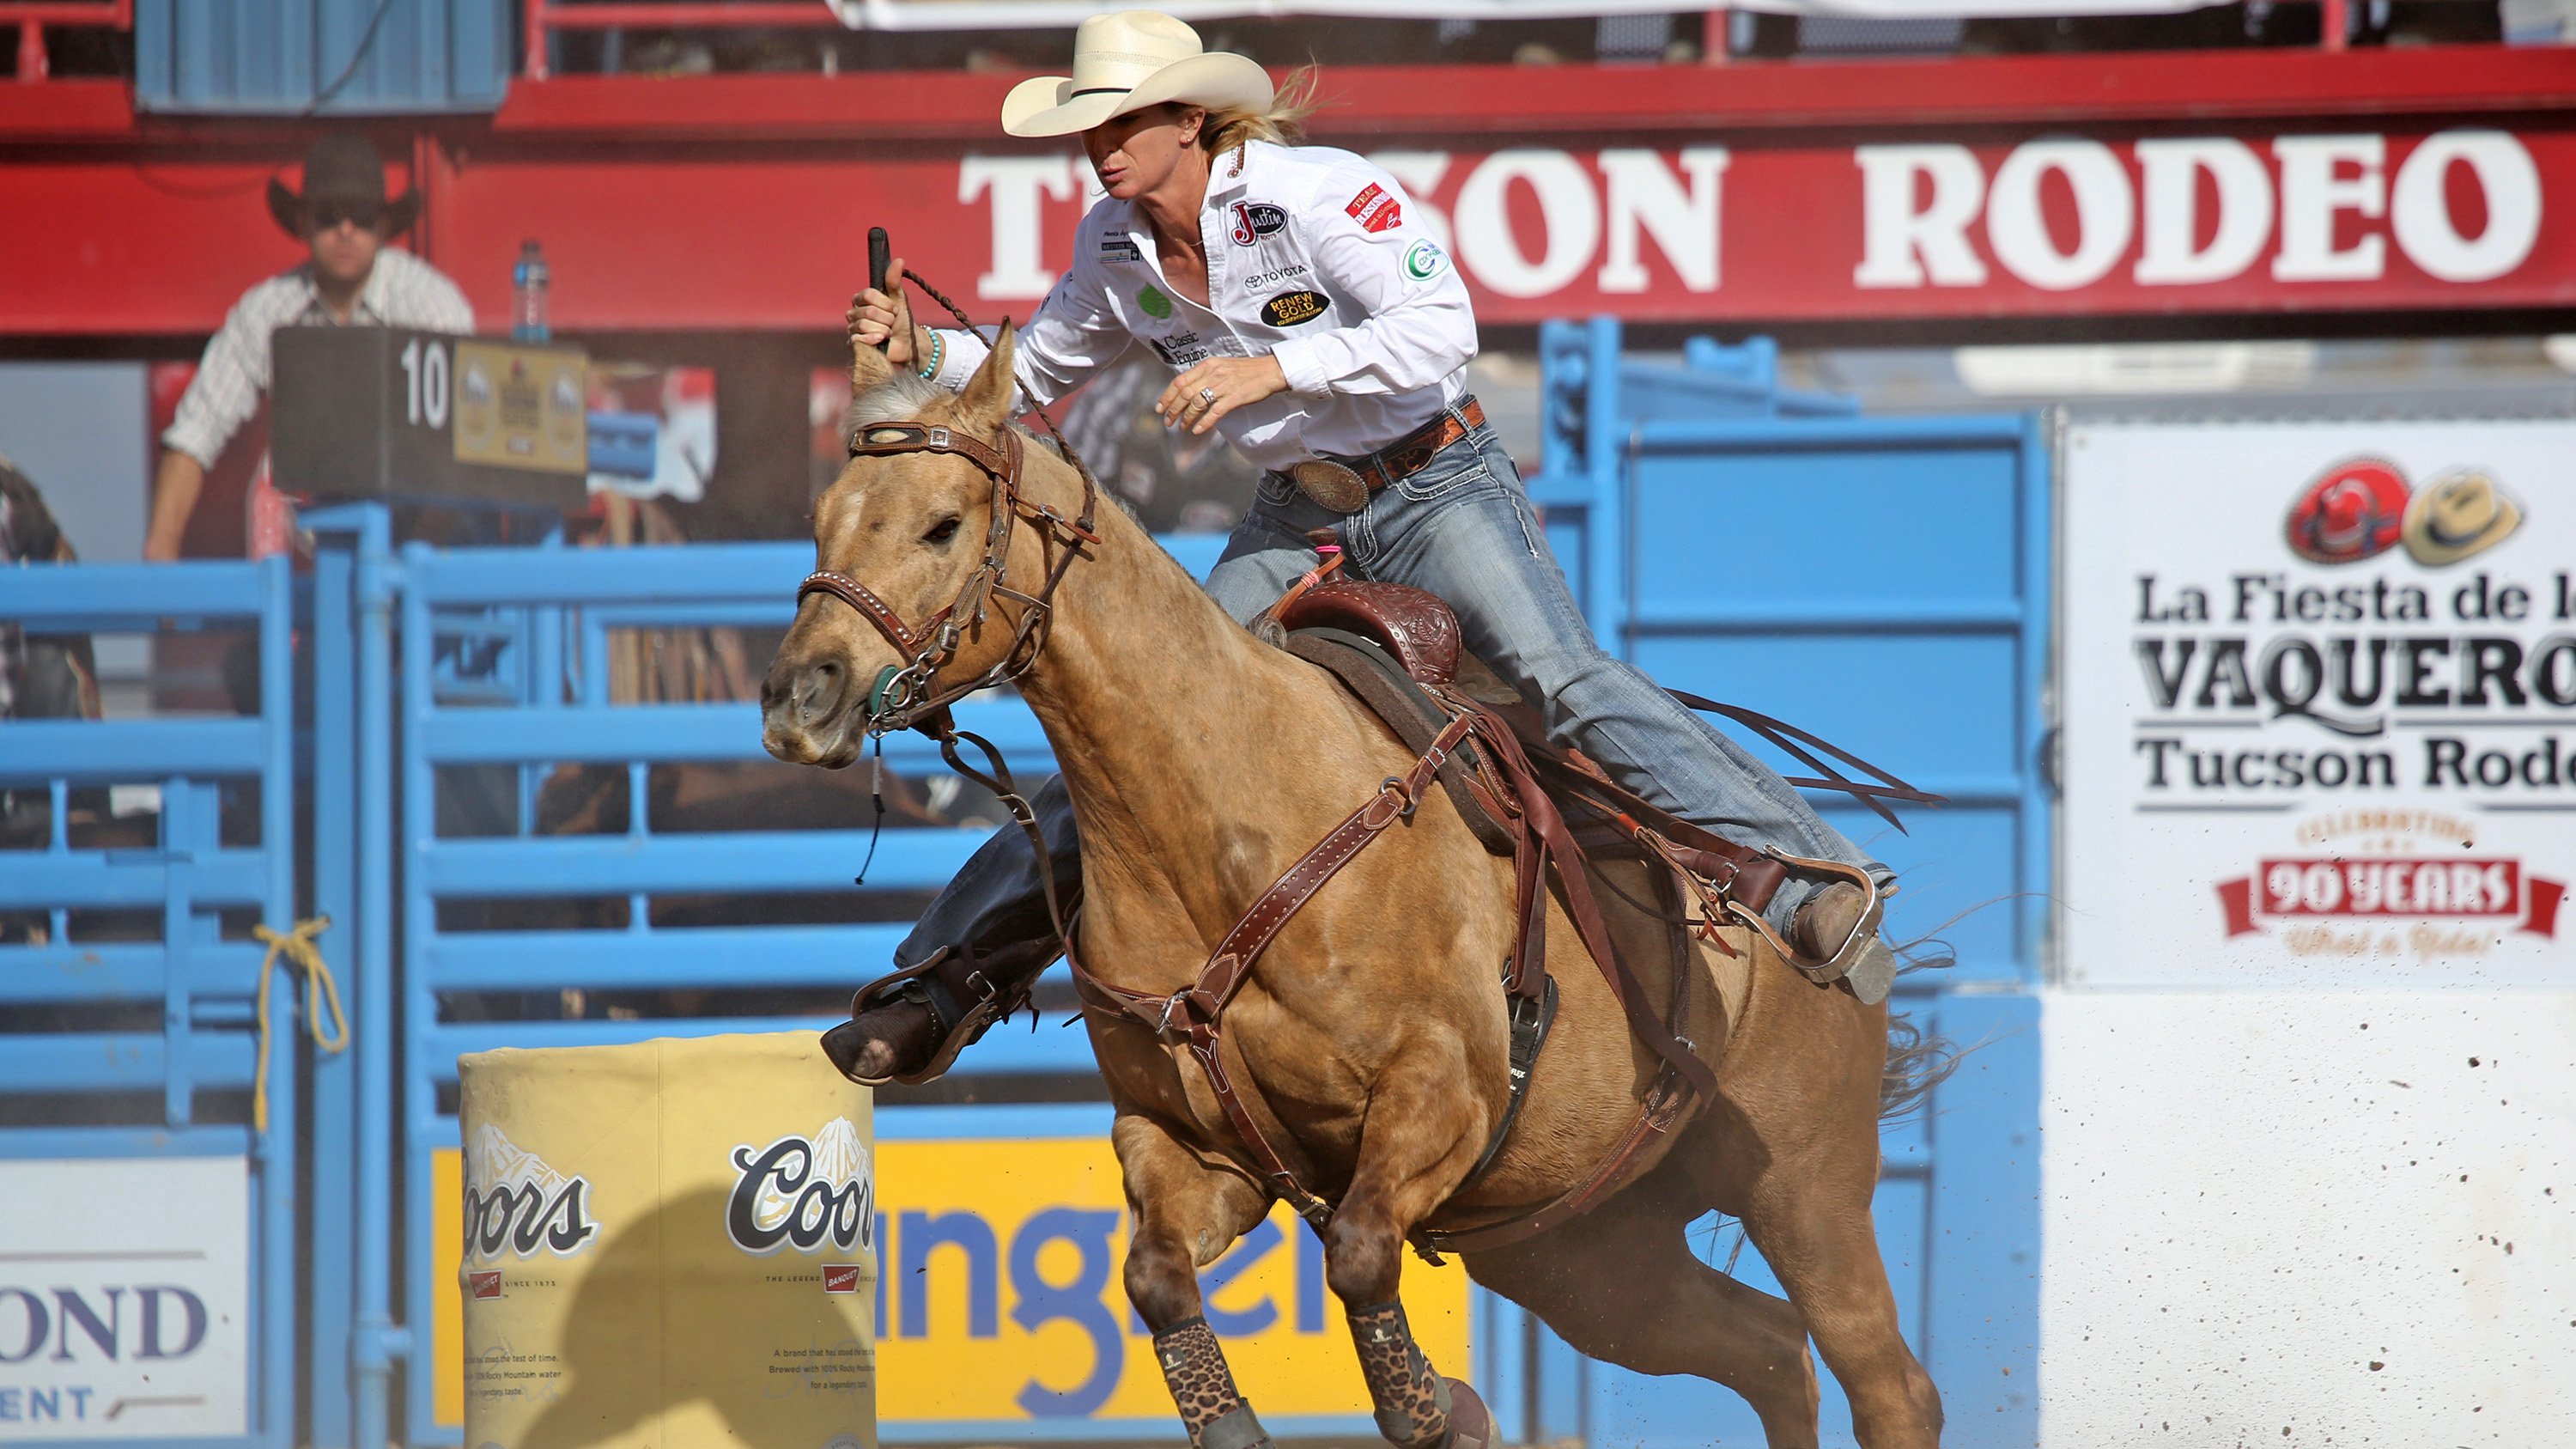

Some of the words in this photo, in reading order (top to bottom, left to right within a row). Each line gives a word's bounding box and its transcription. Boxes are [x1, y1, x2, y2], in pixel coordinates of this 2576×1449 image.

[1852, 129, 2543, 290] RODEO
[1231, 202, 1285, 245] Justin
[1263, 265, 1308, 283] TOYOTA
[1270, 291, 1314, 313] RENEW
[1279, 302, 1315, 320] GOLD
[1164, 330, 1200, 350] Classic
[1172, 348, 1209, 367] Equine
[400, 337, 451, 429] 10
[2136, 574, 2210, 623] La
[2230, 574, 2431, 623] Fiesta
[2451, 574, 2530, 623] de
[2553, 573, 2576, 619] l
[2135, 737, 2397, 790] Tucson
[2264, 861, 2345, 914] 90
[2346, 861, 2512, 914] YEARS
[462, 1147, 597, 1257] oors
[727, 1136, 873, 1253] Coor
[828, 1269, 858, 1287] BANQUET
[512, 1354, 526, 1363] test
[528, 1354, 537, 1362] of
[538, 1354, 559, 1362] time.
[769, 1365, 800, 1373] Brewed
[803, 1365, 819, 1373] with
[503, 1370, 537, 1379] Mountain
[811, 1380, 822, 1389] for
[0, 1386, 94, 1422] ENT
